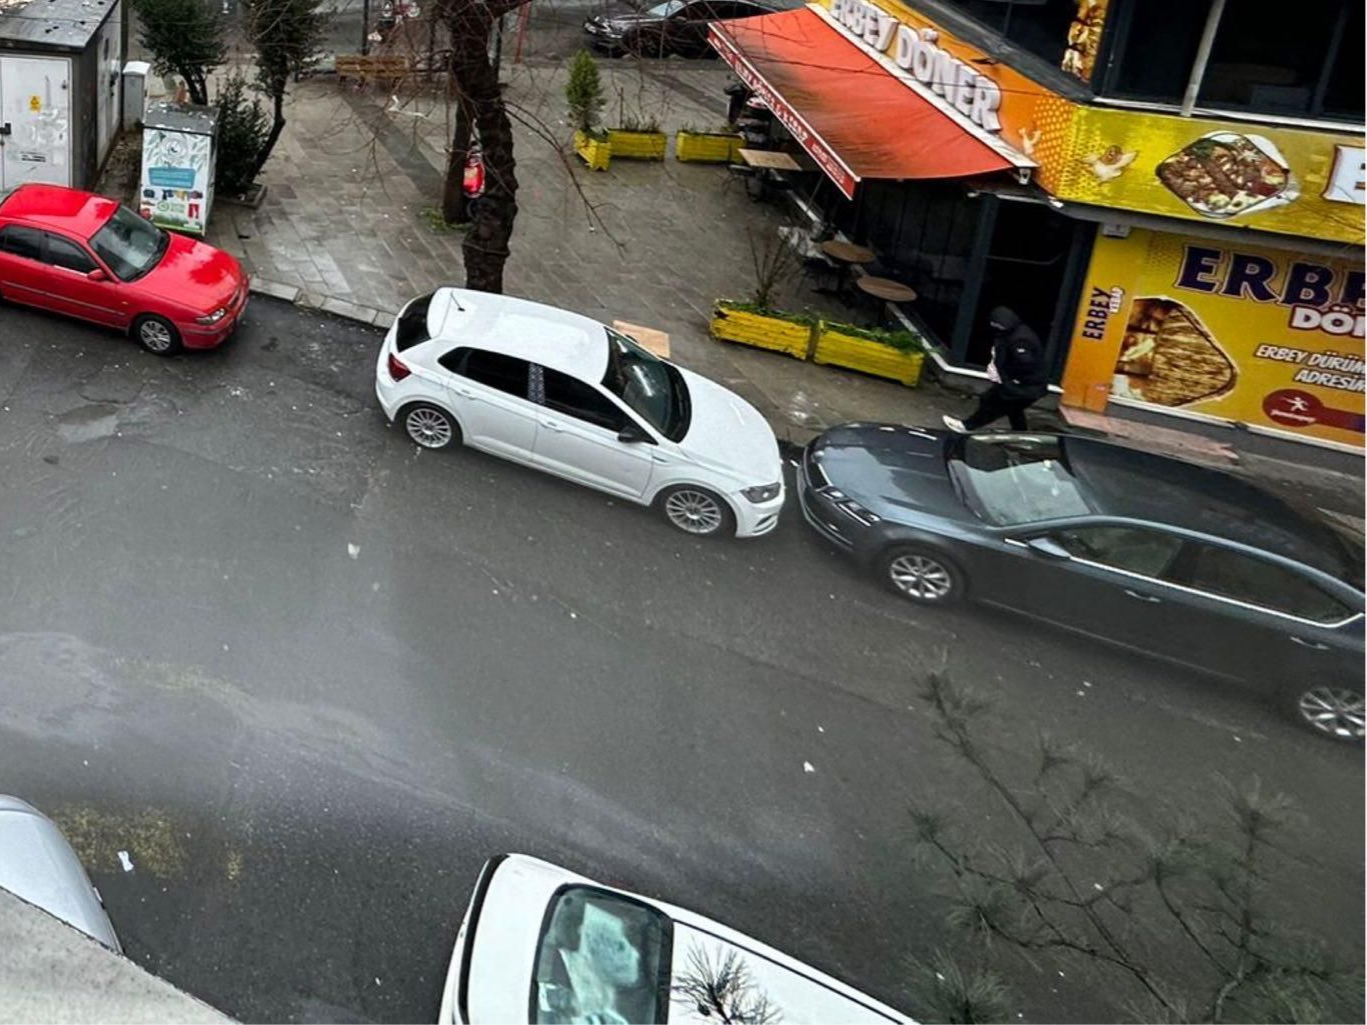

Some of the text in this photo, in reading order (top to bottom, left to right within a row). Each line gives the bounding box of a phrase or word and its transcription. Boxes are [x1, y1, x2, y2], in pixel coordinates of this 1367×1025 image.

[896, 23, 1002, 131] DÖNER
[1082, 286, 1112, 340] ERBEY
[1255, 344, 1308, 364] ERBEY
